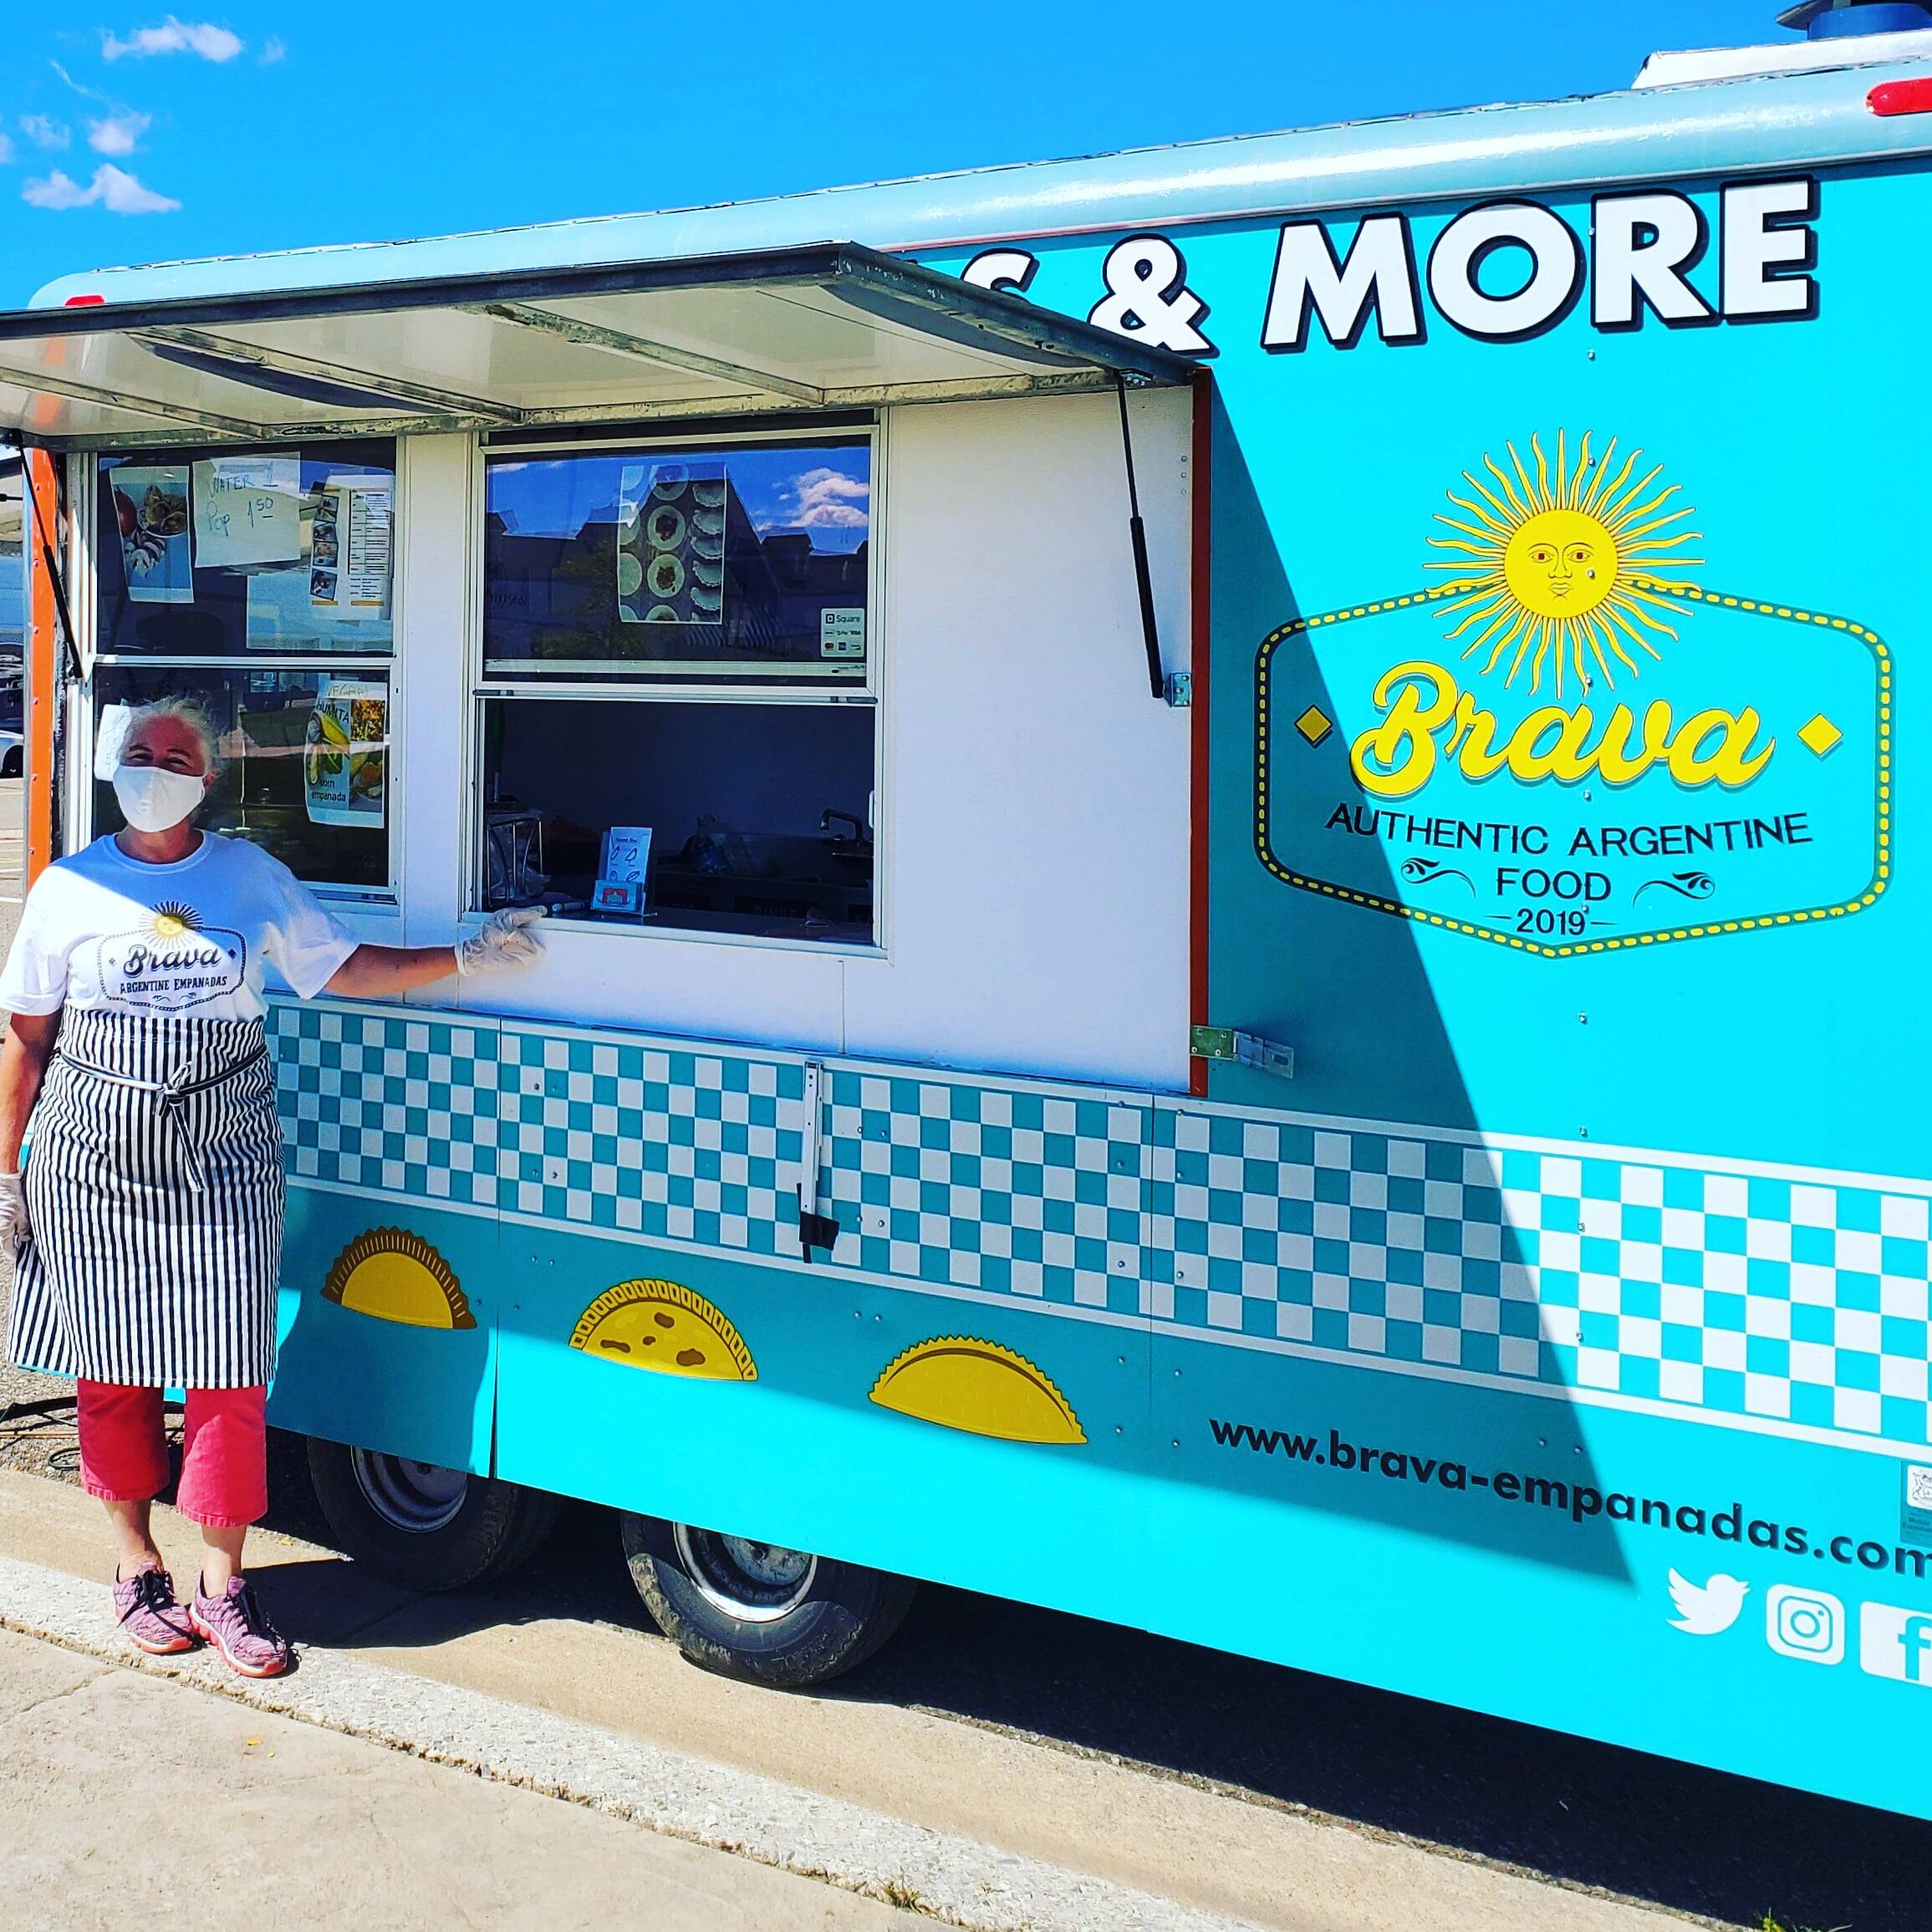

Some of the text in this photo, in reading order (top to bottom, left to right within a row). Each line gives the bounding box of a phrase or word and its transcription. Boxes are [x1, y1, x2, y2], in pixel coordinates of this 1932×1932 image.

[1260, 174, 1821, 354] MORE
[836, 614, 861, 624] Square
[1350, 660, 1776, 798] Brava
[1324, 803, 1813, 858] AUTHENTIC ARGENTINE
[1496, 868, 1612, 901] FOOD
[1516, 908, 1586, 936] 2019
[123, 944, 222, 978] Brava
[120, 976, 227, 994] ARGENTINE EMPANADAS
[1209, 1419, 1932, 1578] www.brava-empanadas.com
